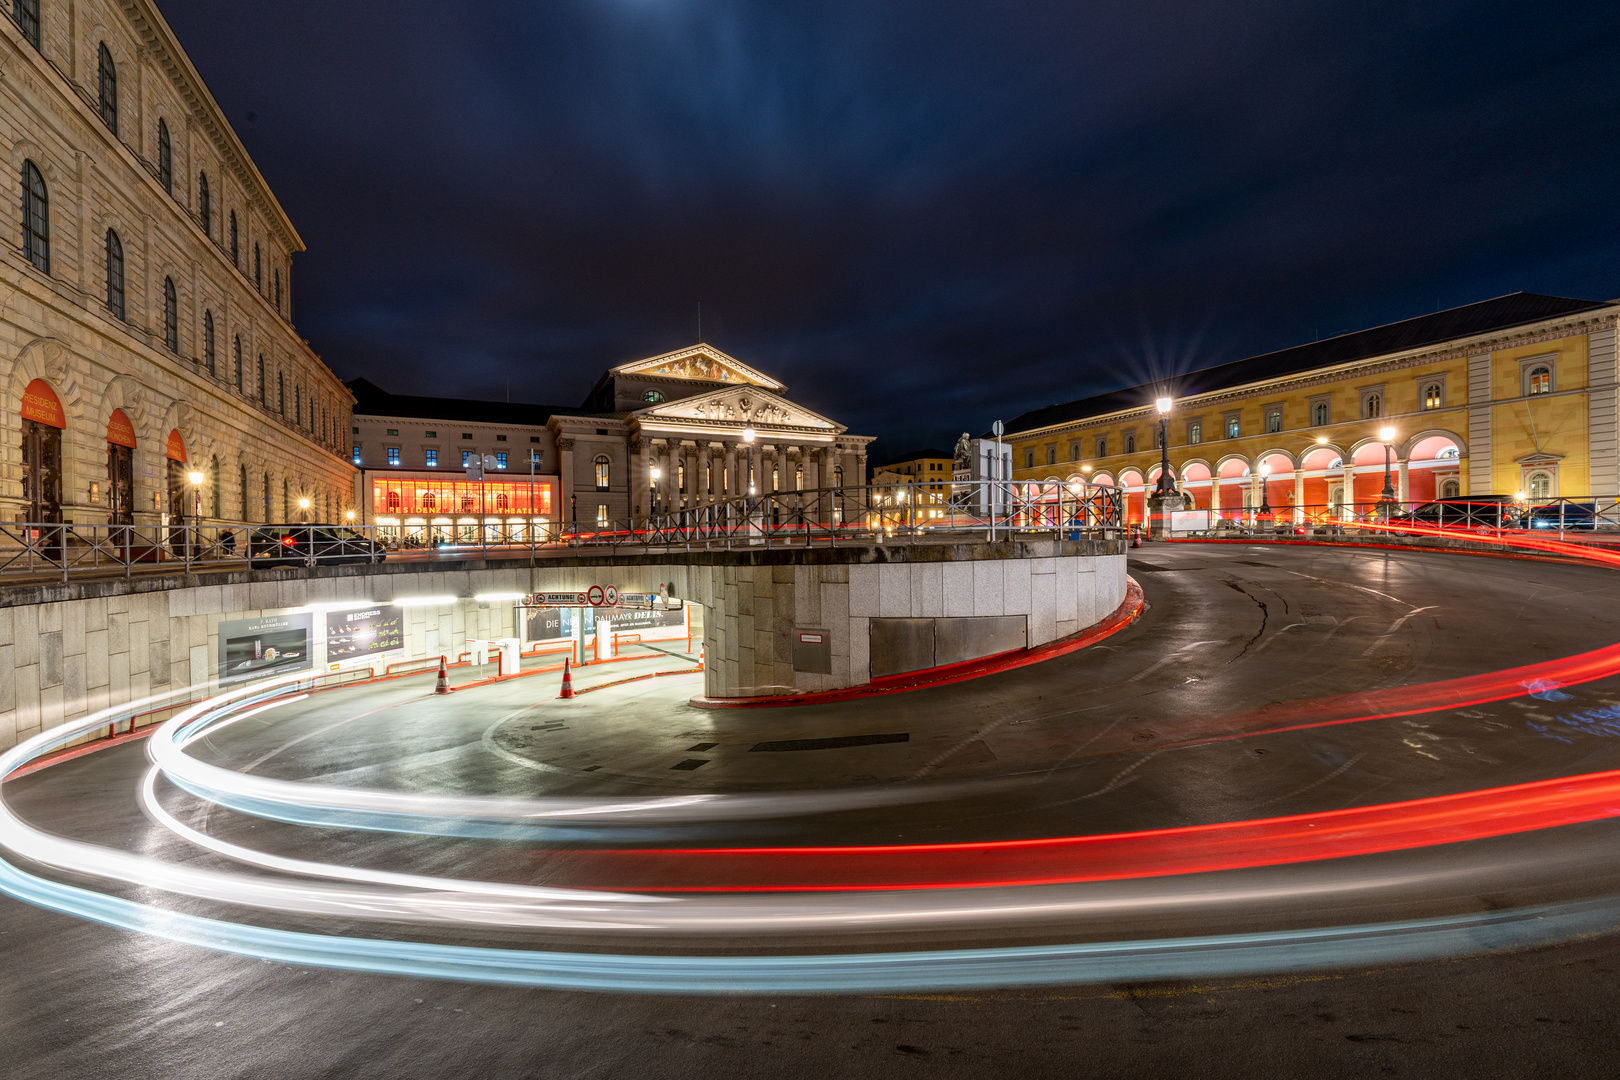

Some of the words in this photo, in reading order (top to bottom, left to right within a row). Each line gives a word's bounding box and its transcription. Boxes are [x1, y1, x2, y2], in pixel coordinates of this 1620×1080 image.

[24, 392, 57, 410] RESIDENZ
[26, 406, 56, 422] MUSEUM
[389, 506, 441, 514] RESIDENZ
[546, 619, 559, 628] DIE
[594, 612, 632, 622] DALLMAYR
[633, 610, 664, 620] DELIS.
